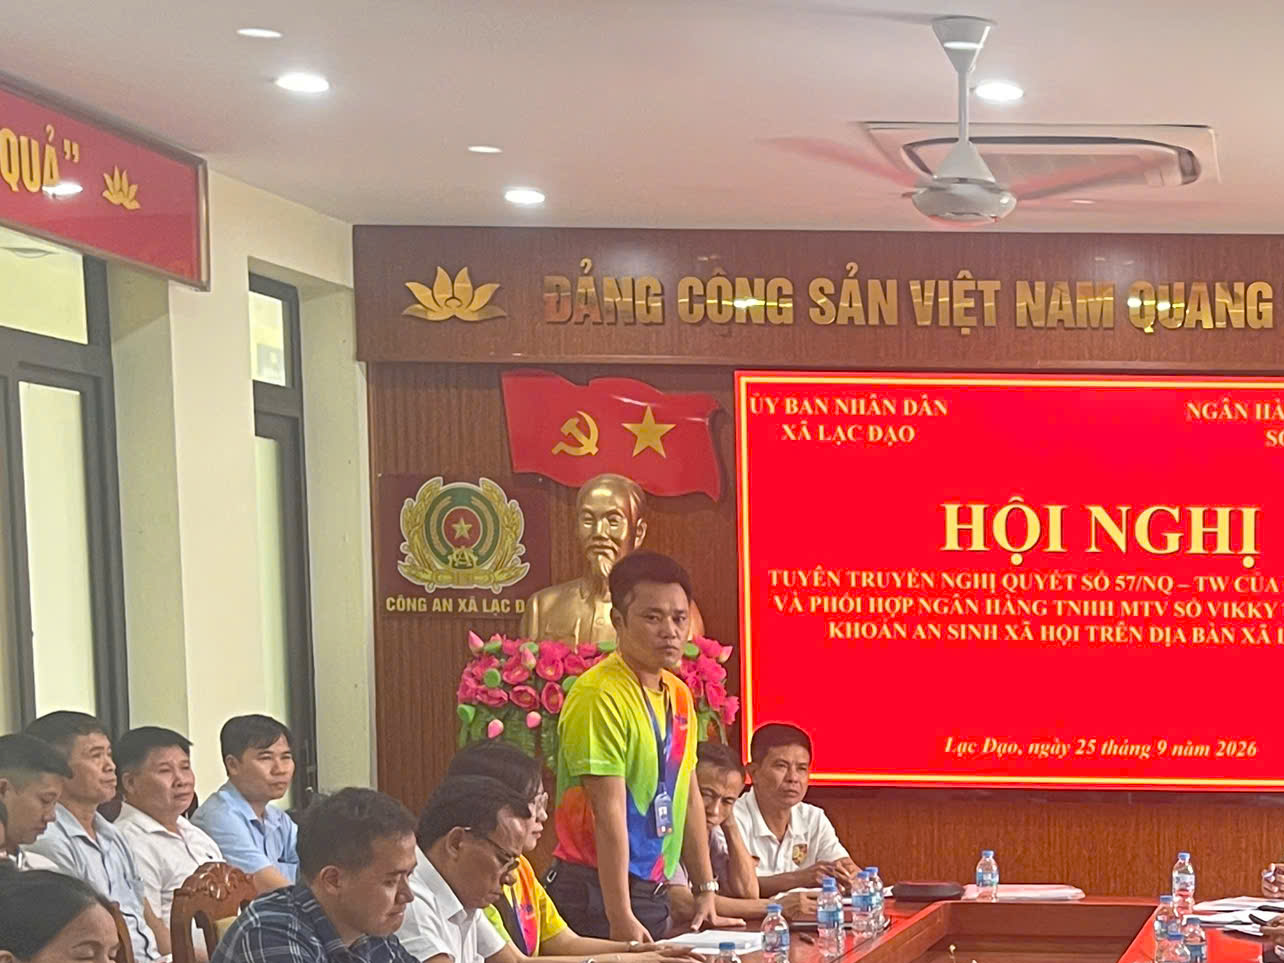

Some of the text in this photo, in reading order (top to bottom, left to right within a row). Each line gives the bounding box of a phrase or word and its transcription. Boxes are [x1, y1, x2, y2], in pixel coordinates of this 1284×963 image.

[543, 257, 665, 326] ĐẢNG
[808, 262, 898, 326] SẢN
[908, 269, 1001, 335] VIỆT
[1015, 280, 1115, 330] NAM
[1128, 280, 1273, 334] QUANG
[785, 397, 829, 415] BAN
[834, 393, 897, 416] NHÂN
[903, 393, 948, 417] DÂN
[1186, 397, 1248, 421] NGÂN
[781, 420, 917, 447] XÃ LẠC ĐẠO
[939, 496, 1262, 569] HỘI NGHỊ
[768, 564, 841, 588] TUYÊN
[845, 567, 935, 589] TRUYỀN
[941, 571, 997, 594] NGHỊ
[1002, 568, 1078, 594] QUYẾT
[1114, 575, 1175, 596] 57/NQ
[1194, 574, 1231, 593] TW
[1234, 569, 1280, 593] CỦA
[386, 594, 428, 612] CÔNG
[432, 598, 453, 612] AN
[458, 595, 478, 613] XÃ
[482, 598, 511, 616] LẠC
[773, 590, 805, 613] VÀ
[810, 592, 862, 614] PHỐI
[868, 595, 914, 618] HỢP
[918, 592, 979, 616] NGÂN
[985, 593, 1049, 617] HÀNG
[1053, 599, 1115, 617] TNHH
[1120, 599, 1169, 618] MTV
[1206, 600, 1279, 619] VIKKY
[828, 617, 908, 641] KHOẢN
[912, 623, 942, 641] AN
[946, 623, 999, 642] SINH
[1003, 619, 1035, 642] XÃ
[1039, 622, 1081, 647] HỘI
[1084, 620, 1145, 645] TRÊN
[1148, 625, 1188, 648] ĐỊA
[1191, 621, 1236, 645] BÀN
[1240, 622, 1272, 645] XÃ
[944, 736, 978, 758] Lạc
[1027, 737, 1071, 759] ngày
[1074, 738, 1097, 756] 25
[1100, 738, 1152, 760] tháng
[1156, 739, 1168, 756] 9
[1170, 739, 1211, 757] năm
[1215, 740, 1257, 758] 2026
